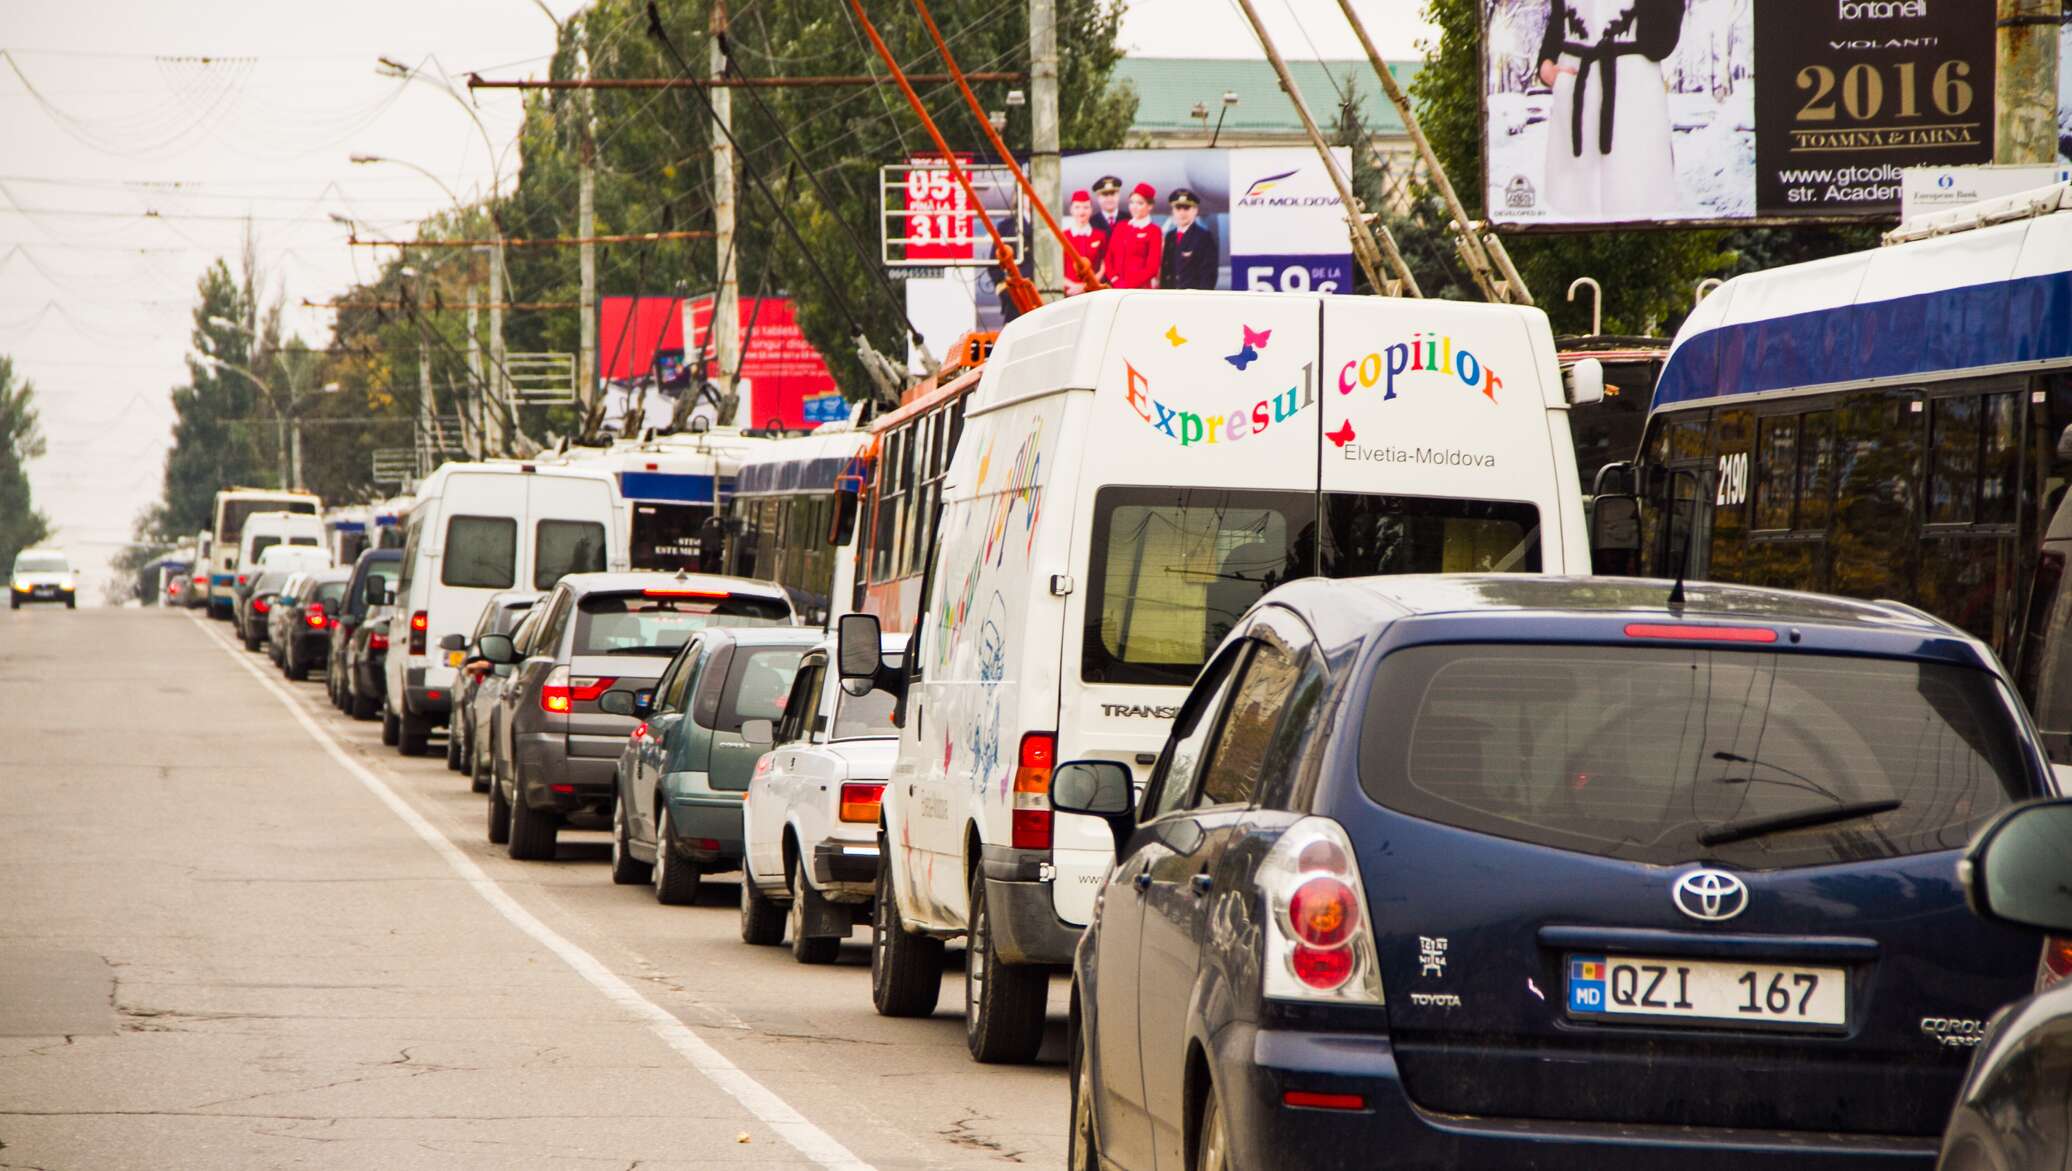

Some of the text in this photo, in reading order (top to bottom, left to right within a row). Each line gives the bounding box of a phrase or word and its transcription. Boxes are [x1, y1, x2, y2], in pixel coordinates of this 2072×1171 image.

[1829, 37, 1938, 49] VIOLANTI
[1796, 60, 1974, 121] 2016
[1888, 131, 1905, 145] &
[1779, 163, 1903, 185] www.gtcolle
[908, 171, 951, 200] 05
[1238, 197, 1265, 206] AIR
[1788, 187, 1818, 202] str.
[911, 214, 949, 246] 31
[1311, 267, 1341, 278] DE LA
[1123, 332, 1503, 447] Expresul copiilor
[1344, 444, 1496, 468] Elvetia-Moldova
[1716, 452, 1748, 506] 2190
[679, 547, 700, 556] MER
[1576, 988, 1600, 1005] MD
[1612, 965, 1819, 1015] QZI 167
[1410, 993, 1462, 1007] TOYOTA
[1921, 1018, 1984, 1033] COROL
